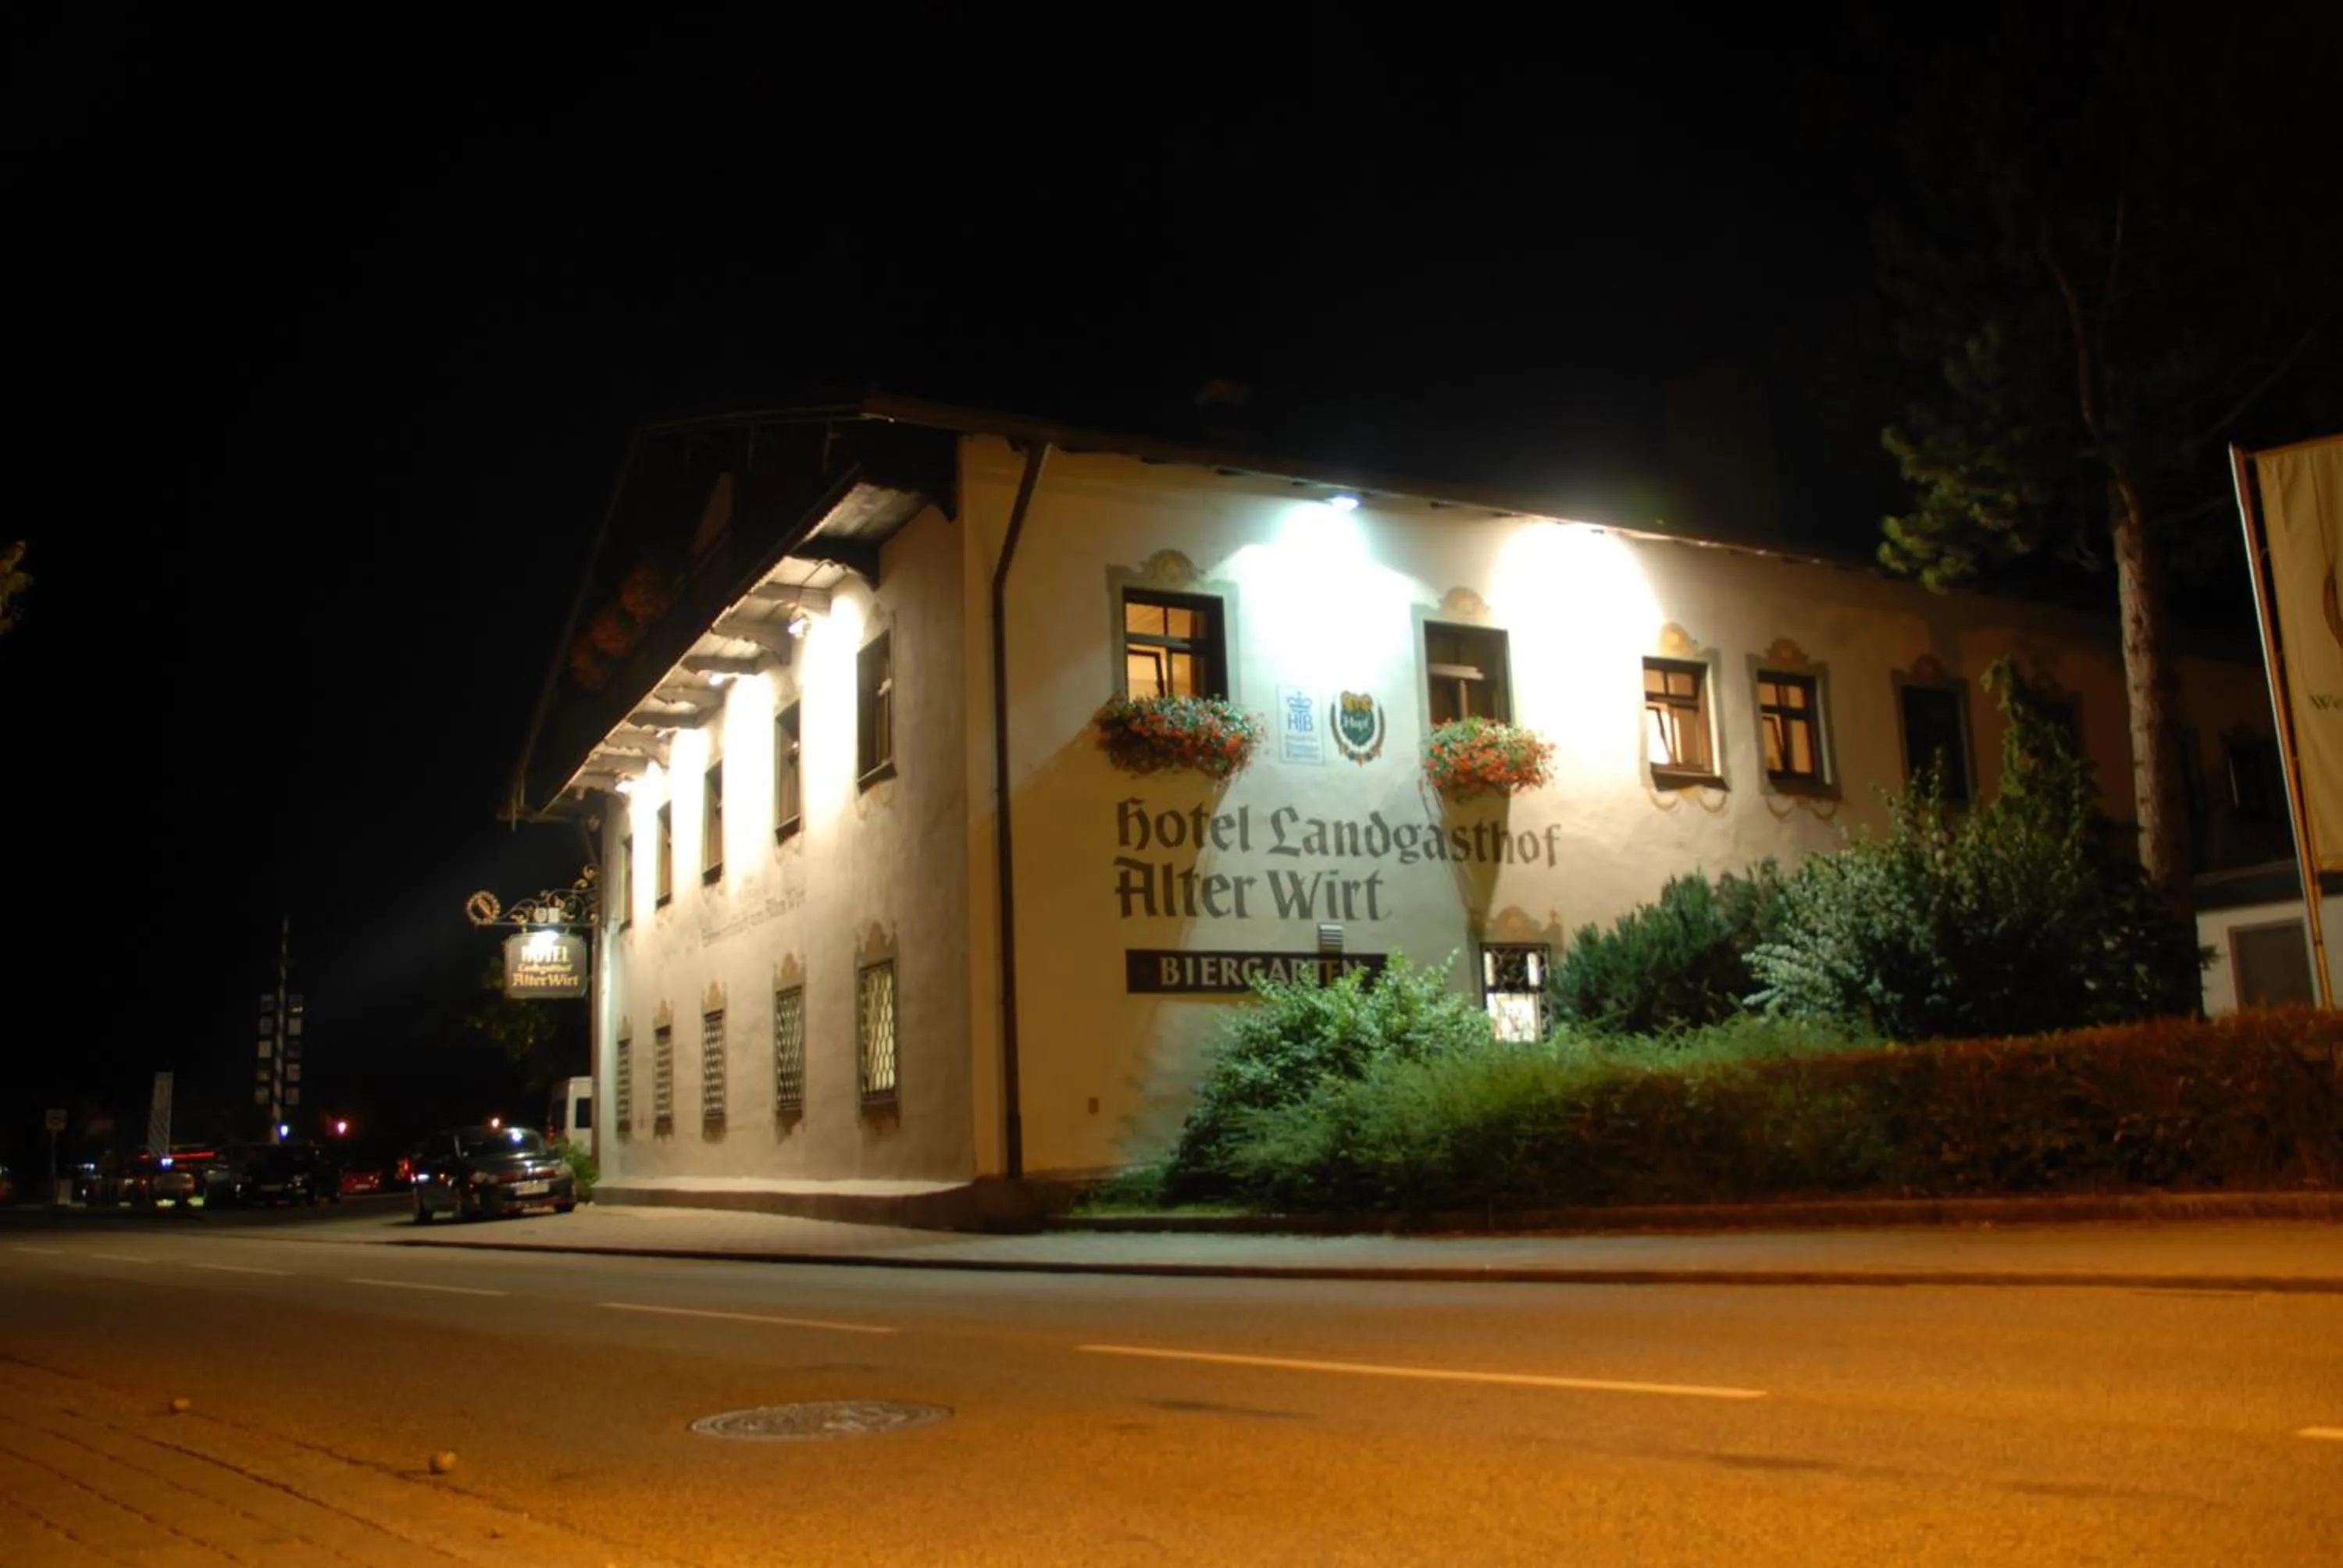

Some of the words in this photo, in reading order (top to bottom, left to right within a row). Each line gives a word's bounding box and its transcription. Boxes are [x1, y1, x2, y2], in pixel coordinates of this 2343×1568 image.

[1116, 798, 1252, 853] Hotel
[1267, 805, 1562, 869] Landgasthof
[1114, 857, 1256, 920] Alter
[1266, 869, 1393, 921] Wirt
